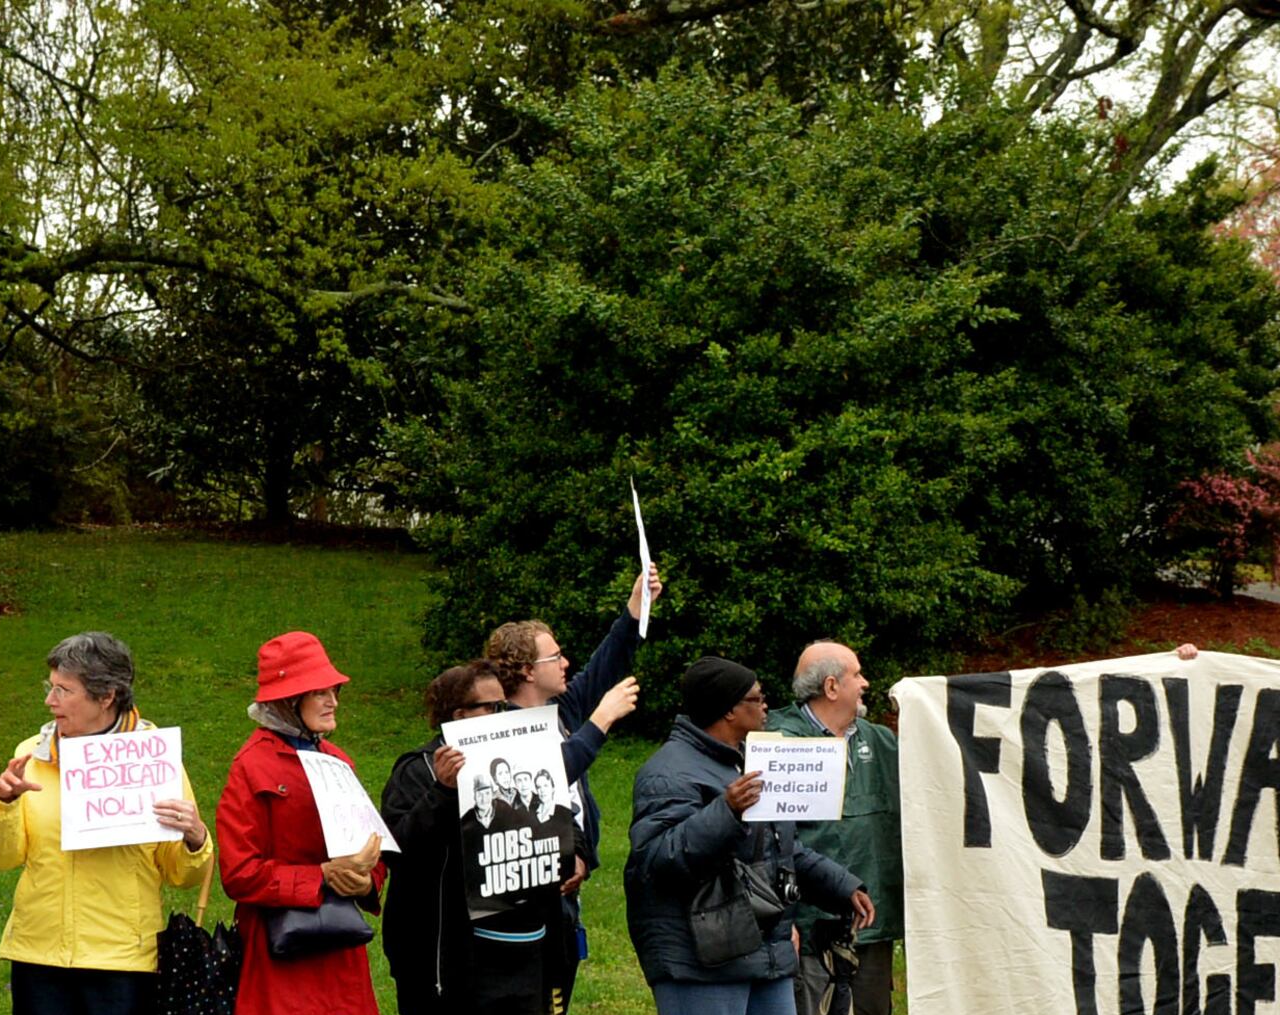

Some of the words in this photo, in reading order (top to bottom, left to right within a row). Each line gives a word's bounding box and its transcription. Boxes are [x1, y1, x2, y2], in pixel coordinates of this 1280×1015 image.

[458, 733, 488, 747] HEALTH
[490, 729, 511, 742] CARE
[512, 727, 528, 737] FOR
[530, 722, 549, 734] ALL!
[83, 735, 167, 764] EXPAND
[751, 745, 771, 753] Dear
[774, 745, 813, 754] Governor
[816, 745, 838, 755] Deal,
[65, 759, 177, 791] MEDICAID
[768, 760, 824, 774] Expand
[761, 780, 828, 793] Medicaid
[776, 801, 810, 813] Now
[478, 826, 533, 867] JOBS
[534, 835, 561, 856] WITH
[480, 852, 562, 898] JUSTICE
